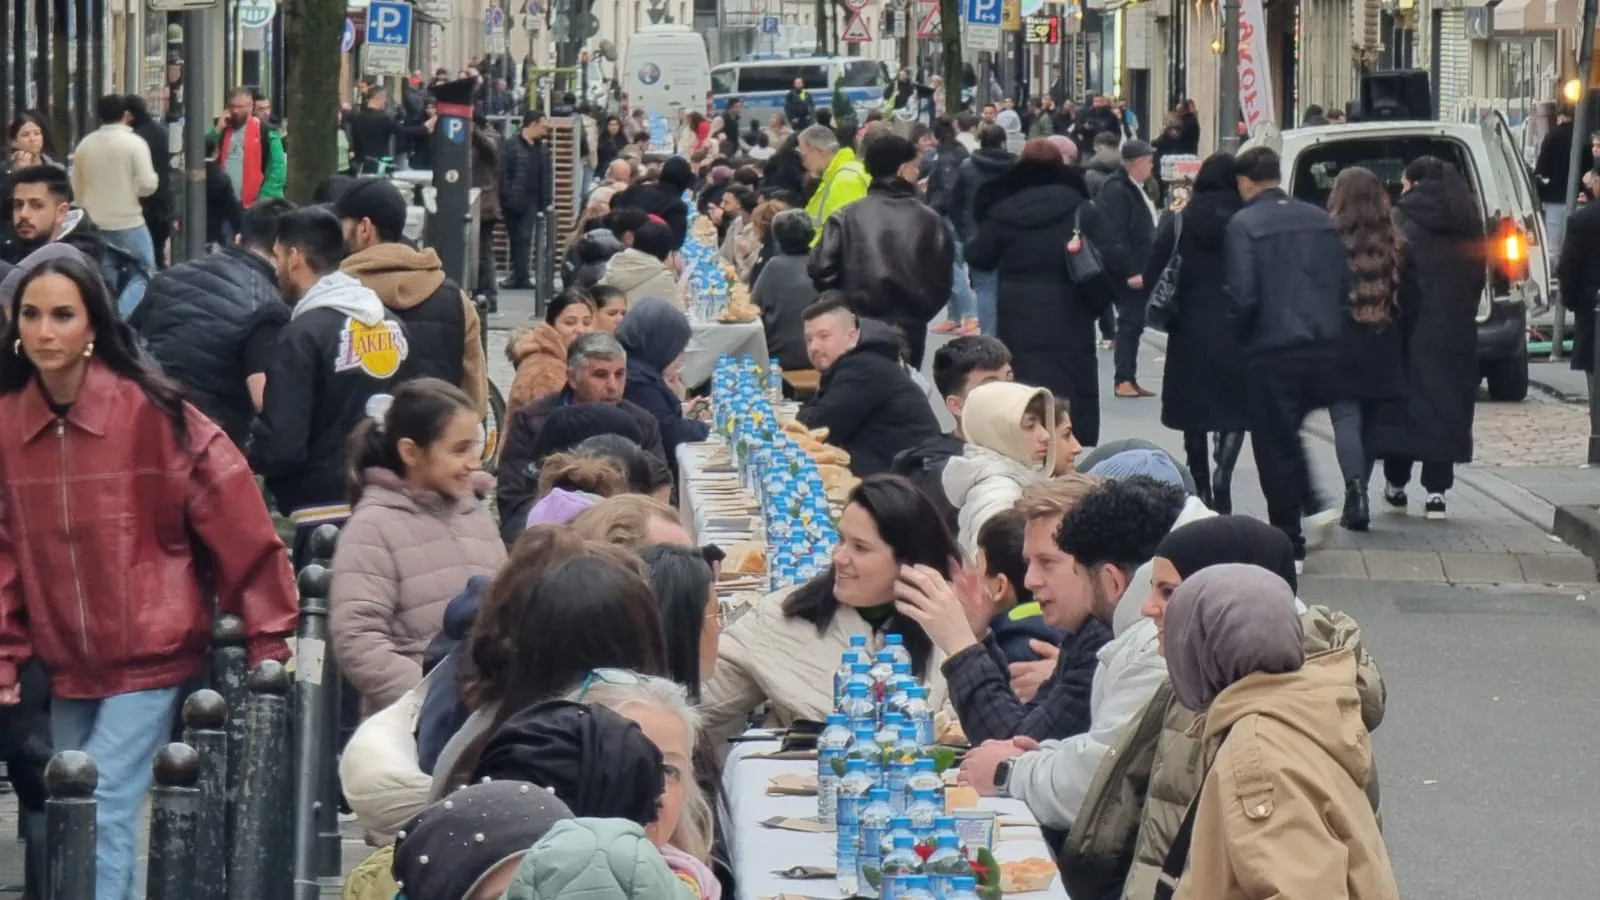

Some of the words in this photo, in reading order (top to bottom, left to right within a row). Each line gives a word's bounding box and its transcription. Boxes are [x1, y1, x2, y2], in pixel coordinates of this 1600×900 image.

[975, 0, 995, 20] P
[376, 6, 401, 39] P
[447, 119, 463, 140] P
